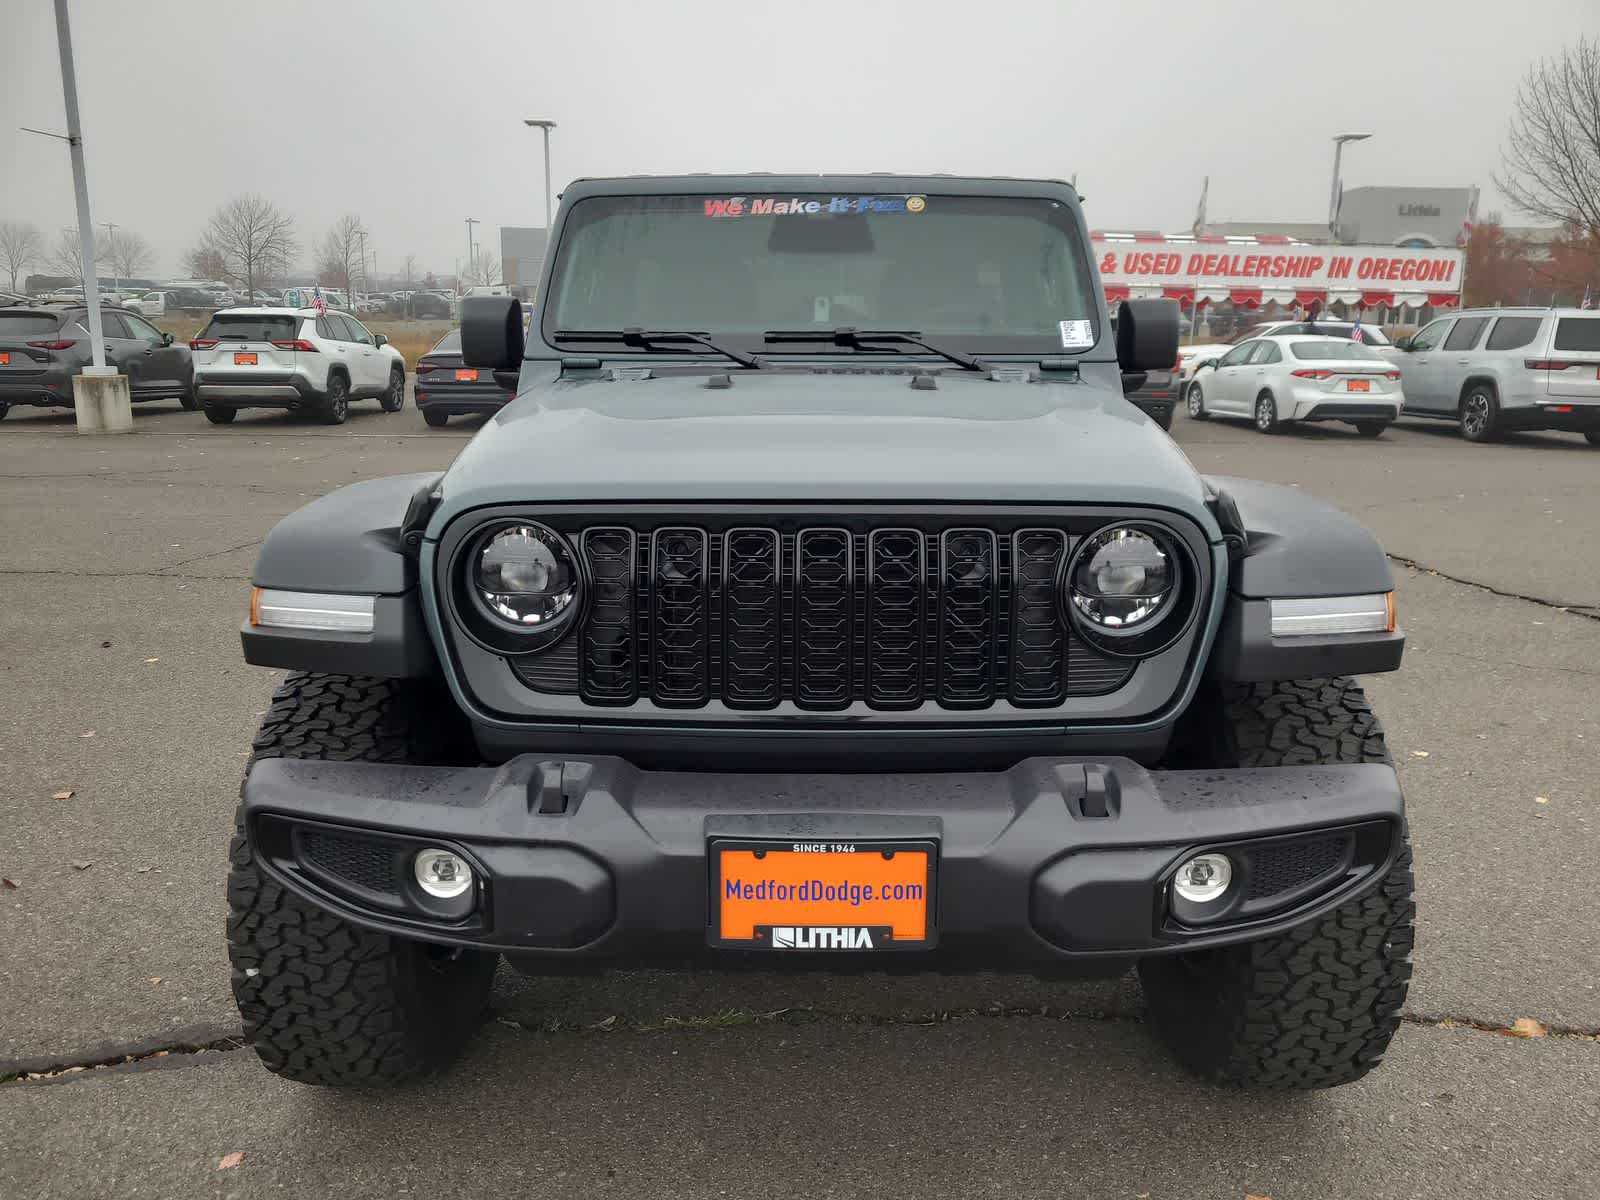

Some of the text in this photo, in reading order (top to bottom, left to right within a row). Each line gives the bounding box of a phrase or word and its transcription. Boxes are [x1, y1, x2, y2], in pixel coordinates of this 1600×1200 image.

[704, 197, 746, 217] We
[750, 198, 821, 215] Make
[1100, 251, 1456, 282] & USED DEALERSHIP IN OREGON!
[793, 844, 856, 853] SINCE 1946
[725, 879, 923, 906] MedfordDodge.com
[795, 927, 874, 949] LITHIA
